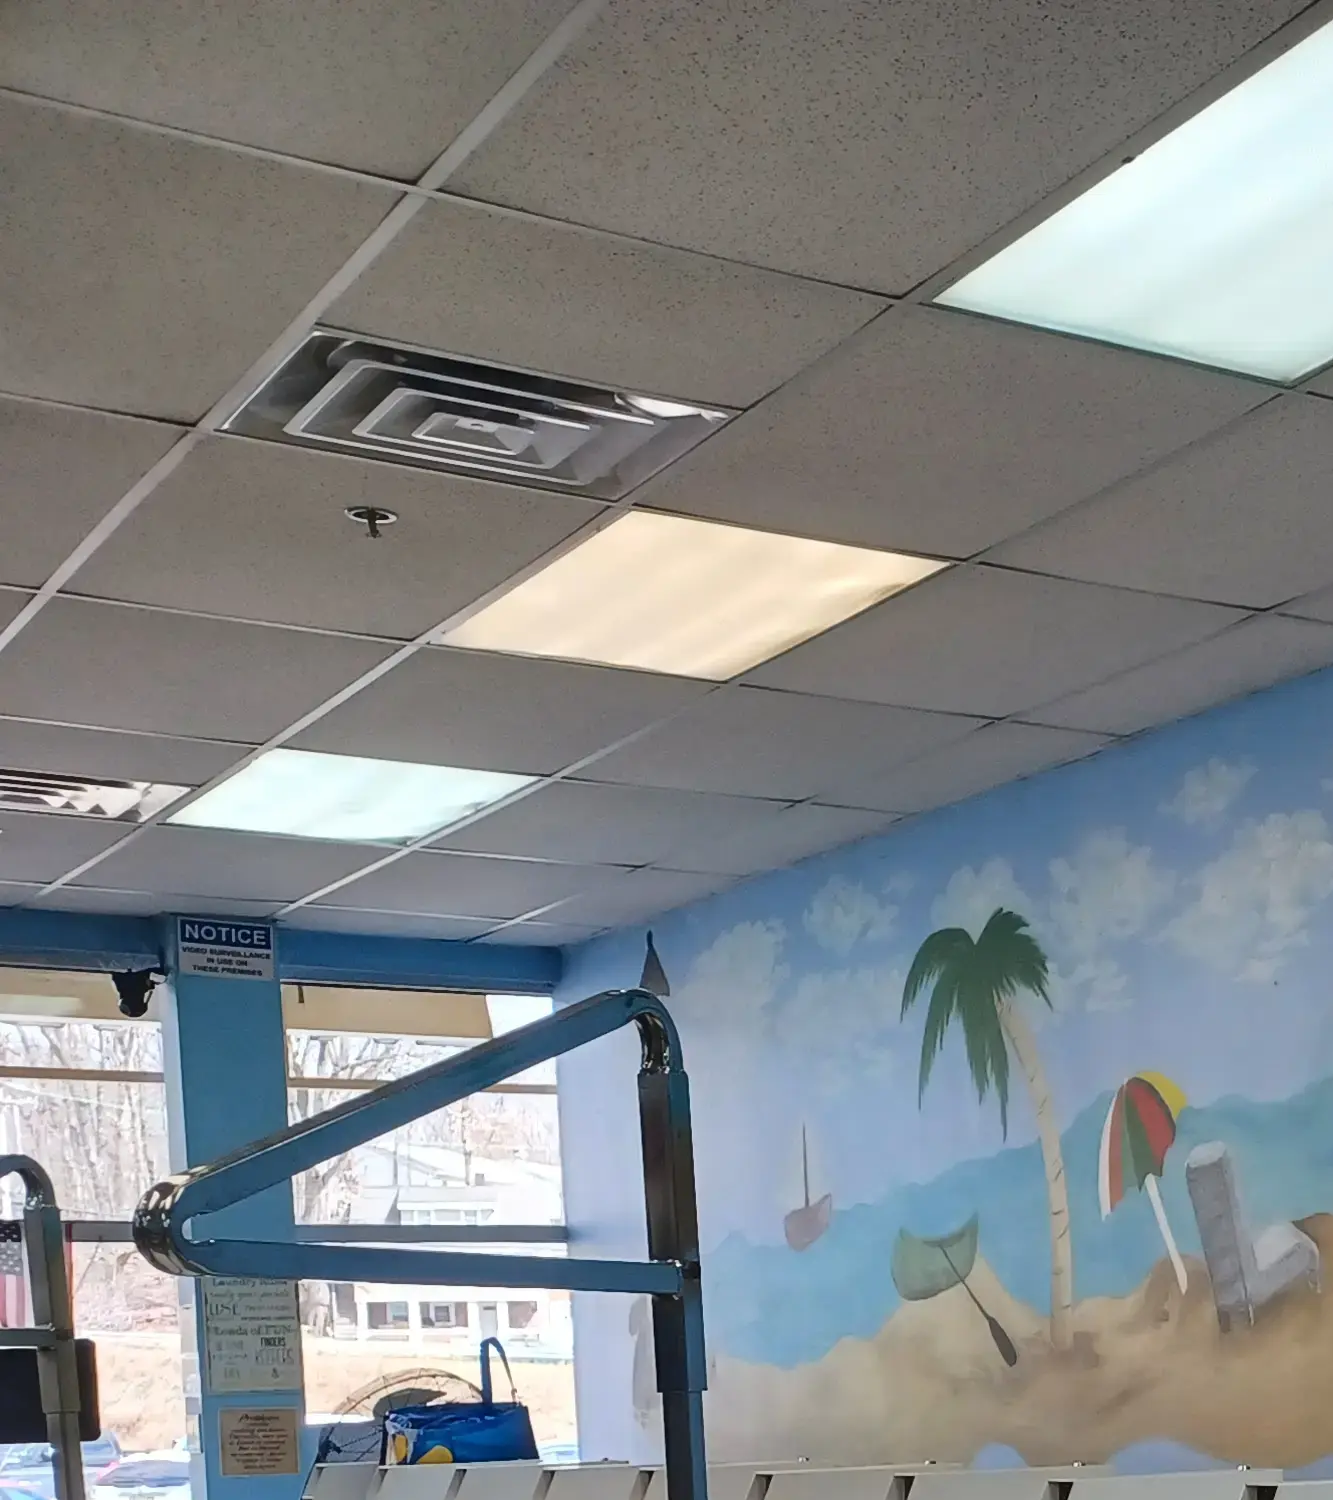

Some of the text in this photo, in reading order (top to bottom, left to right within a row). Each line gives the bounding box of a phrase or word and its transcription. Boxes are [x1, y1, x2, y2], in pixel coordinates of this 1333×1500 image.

[185, 923, 267, 946] NOTICE
[182, 946, 270, 960] VIDEO SURVEILLANCE
[206, 956, 248, 967] IN USE ON
[192, 964, 263, 977] THESE PREMISES
